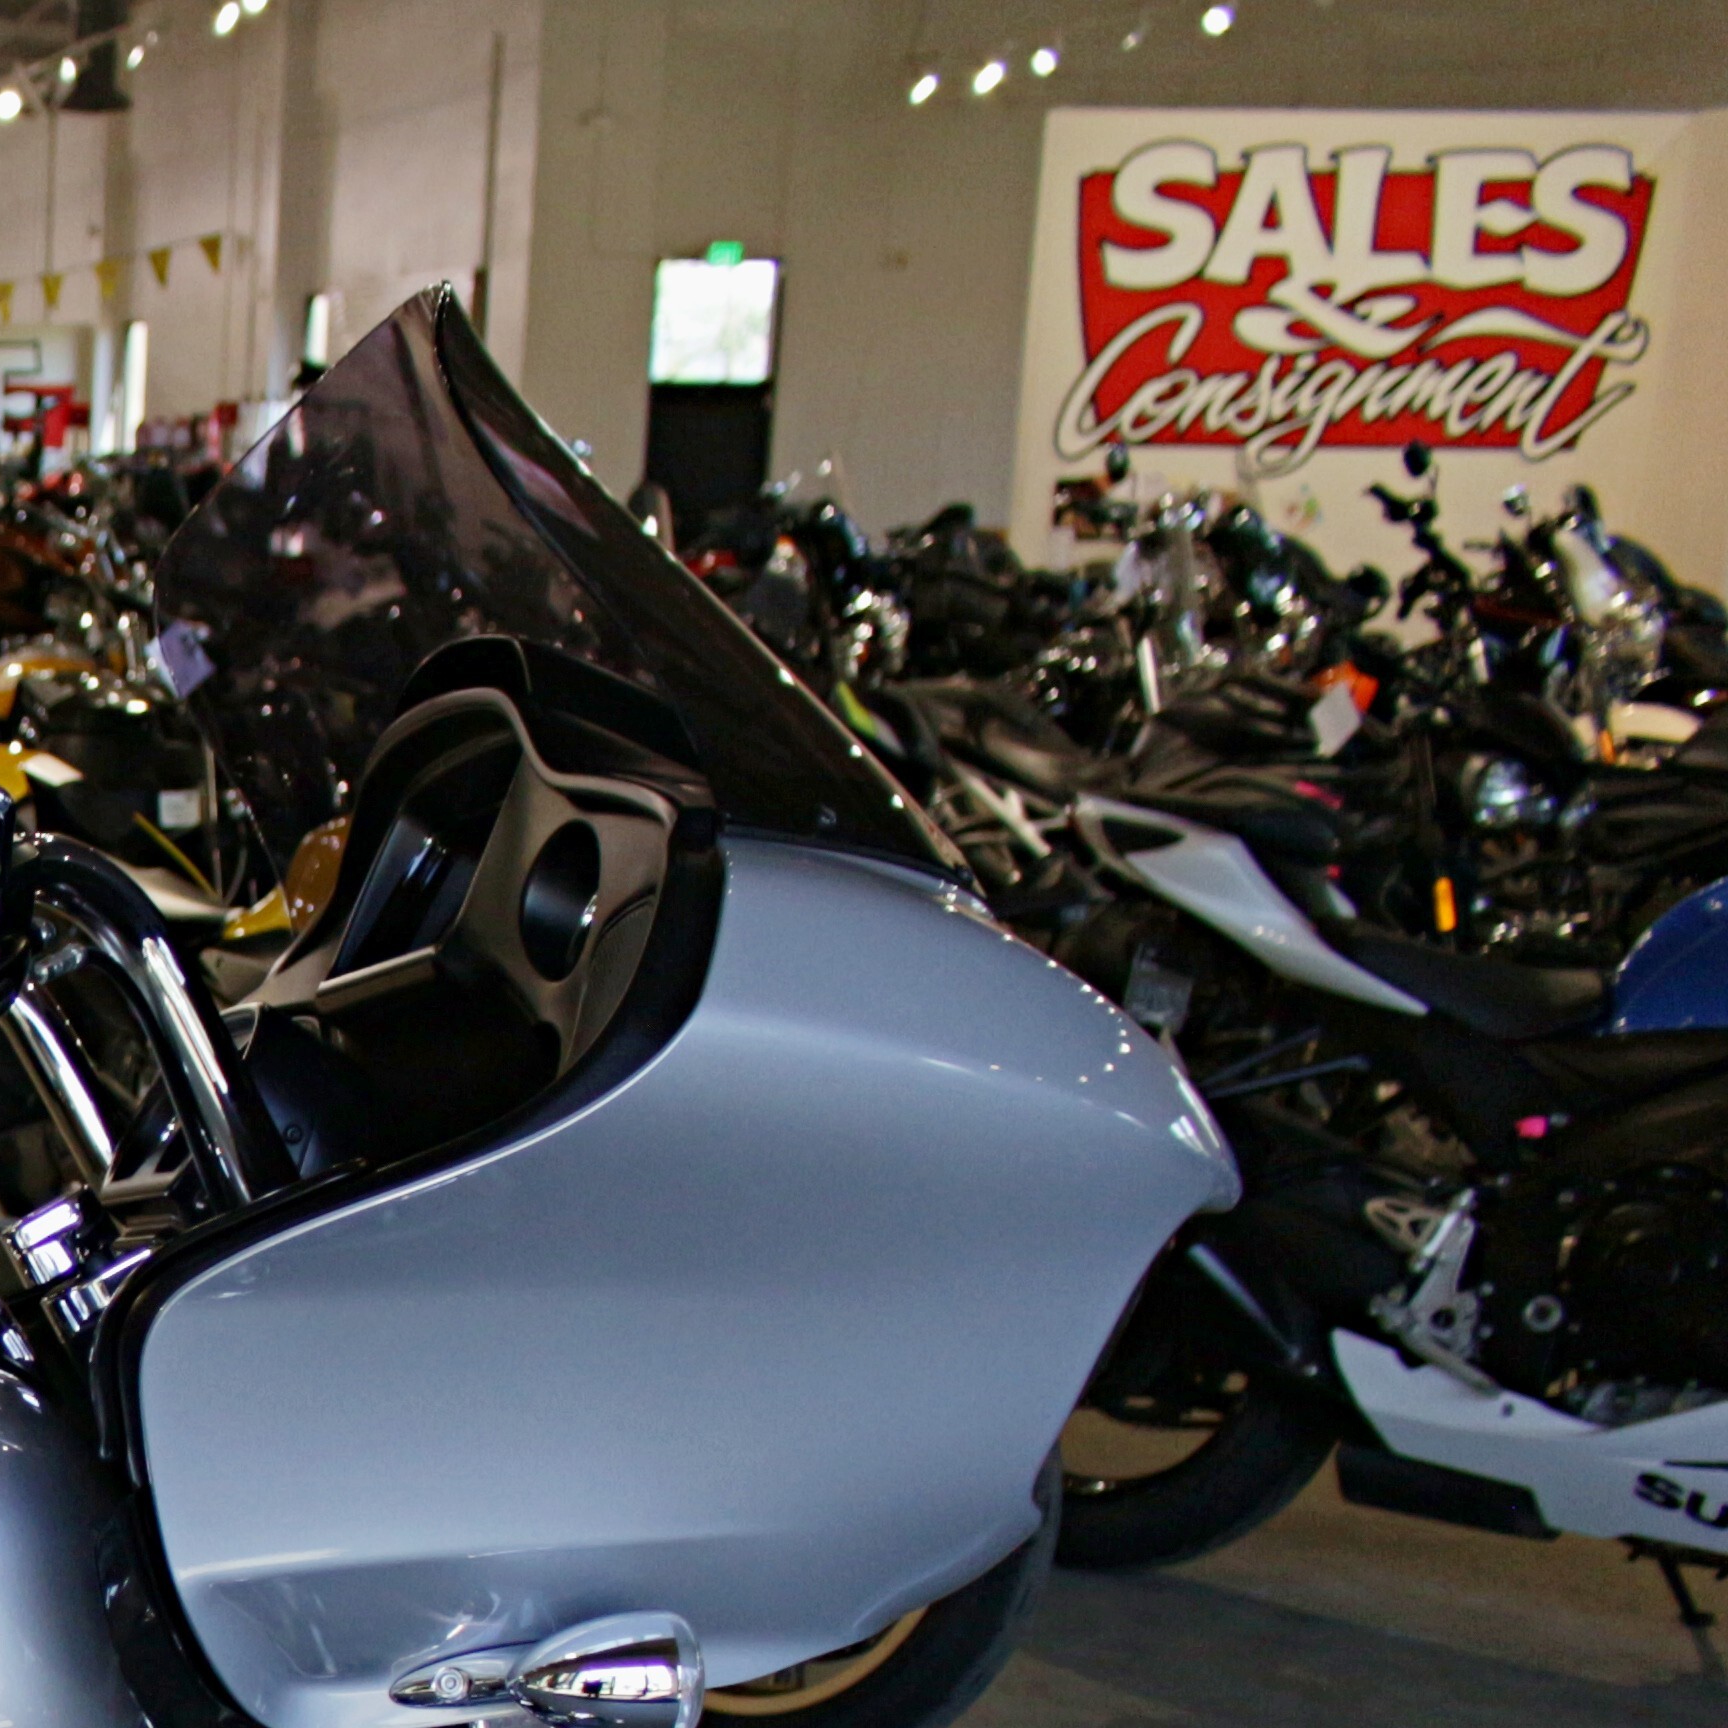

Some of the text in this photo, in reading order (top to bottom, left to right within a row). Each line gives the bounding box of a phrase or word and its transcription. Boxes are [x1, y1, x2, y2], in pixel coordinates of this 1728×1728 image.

[1100, 138, 1636, 299] SALES
[1052, 300, 1650, 480] Consignment
[1232, 276, 1444, 360] &
